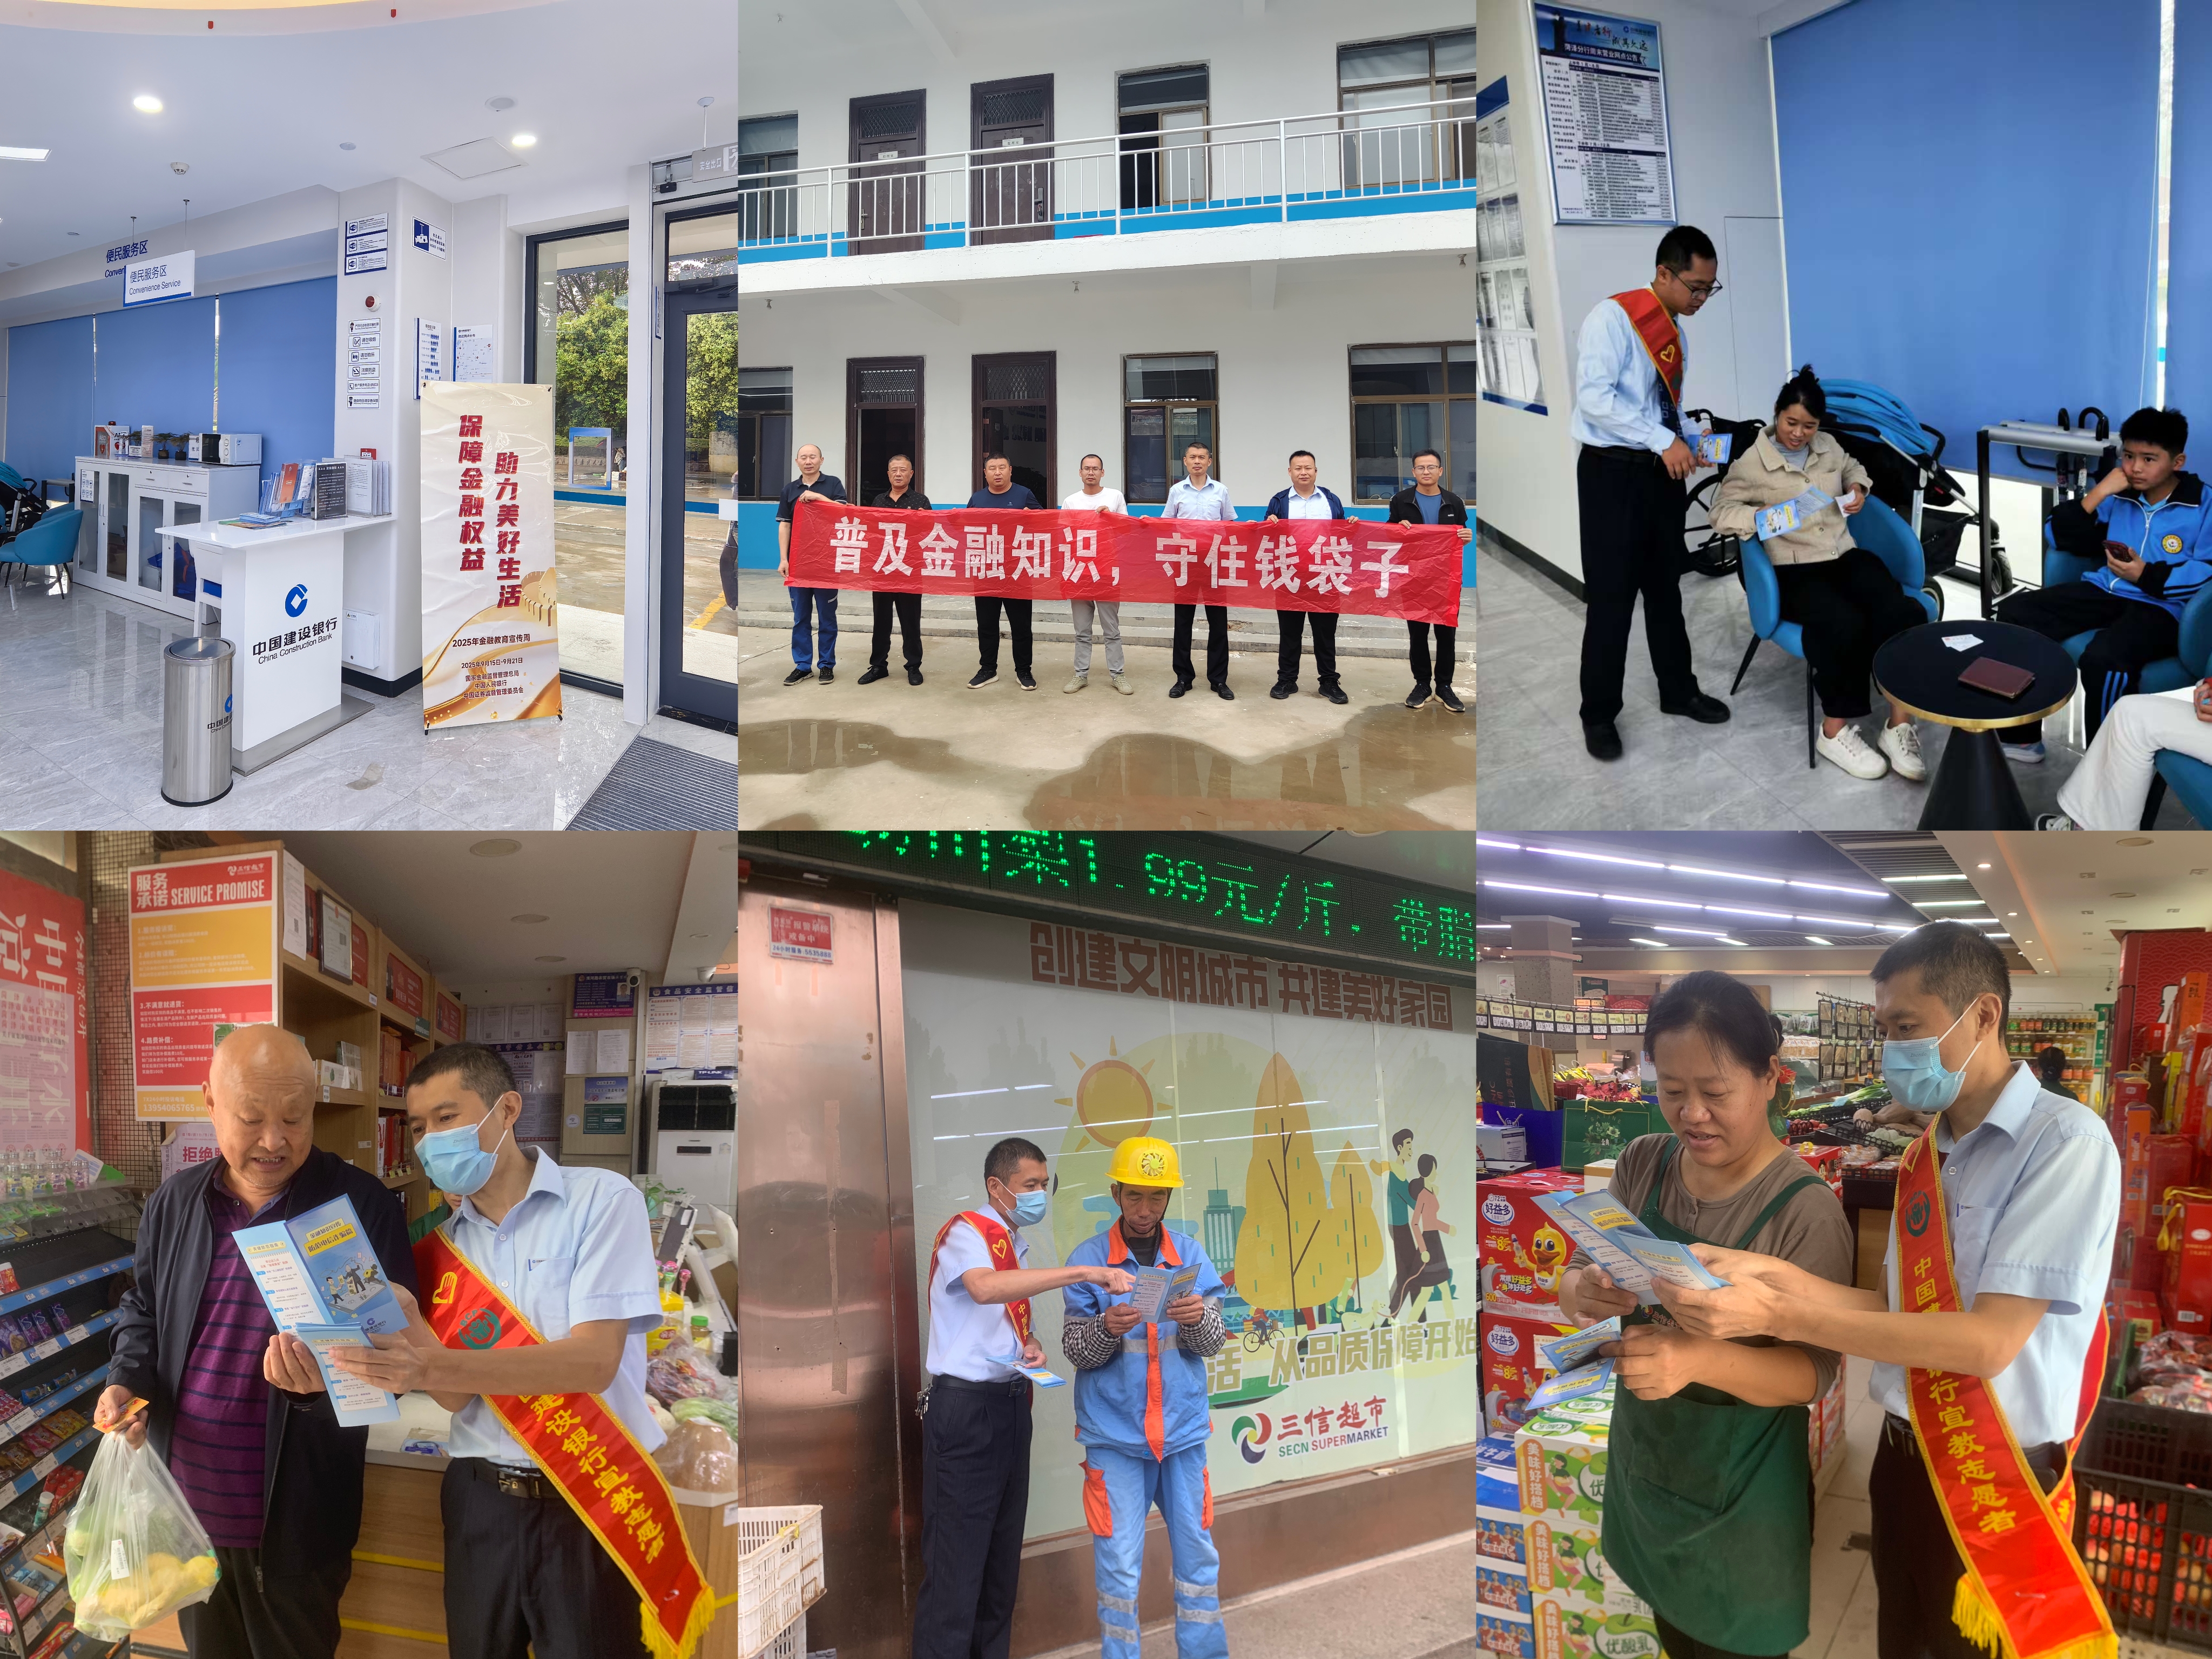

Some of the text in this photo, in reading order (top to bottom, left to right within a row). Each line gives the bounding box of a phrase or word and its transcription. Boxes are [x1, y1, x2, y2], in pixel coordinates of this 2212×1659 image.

[700, 158, 721, 171] 安全出口
[106, 240, 149, 264] 便民服务区
[130, 265, 167, 284] 便民服务区
[129, 280, 181, 295] Convenience Service
[458, 414, 486, 571] 保障金融权益
[494, 451, 522, 608] 助力美好生活
[252, 617, 339, 656] 中国建设银行
[452, 633, 531, 648] 2025年金融教育宣传周
[258, 633, 333, 665] China Construction Bank
[461, 657, 523, 669] 2025年9月15日-9月21日
[465, 670, 520, 682] 国家金融监督管理总局
[474, 679, 508, 689] 中国人民银行
[463, 686, 524, 699] 中国证券监督管理委员会
[136, 872, 168, 892] 服务
[136, 879, 265, 909] 承诺 SERVICE PROMISE
[789, 932, 815, 943] 戒备中
[1030, 921, 1453, 1031] 创建文明城市 共建美好家园
[143, 1104, 195, 1112] 13954065765
[1590, 1113, 1622, 1125] SATINE
[1600, 1137, 1610, 1147] 金典
[1485, 1203, 1510, 1216] 好益多
[309, 1221, 342, 1239] 金融知识宣传
[252, 1243, 279, 1251] 关键防范指南
[307, 1228, 354, 1253] 防范电信诈骗篇
[1500, 1274, 1533, 1285] 常喝好益多
[1486, 1292, 1497, 1302] 600
[1501, 1284, 1533, 1295] 身体好处多
[1491, 1333, 1515, 1346] 好益多
[1269, 1317, 1477, 1387] 从品质保障开始
[1277, 1394, 1387, 1441] 三信超市
[1491, 1419, 1502, 1428] 600
[1278, 1426, 1389, 1458] SECN SUPERMARKET
[517, 1394, 665, 1564] 建设银行宣教志愿者
[1526, 1441, 1543, 1509] 美味好搭档
[1534, 1522, 1551, 1589] 美味好搭档
[1605, 1635, 1653, 1655] 优酸乳
